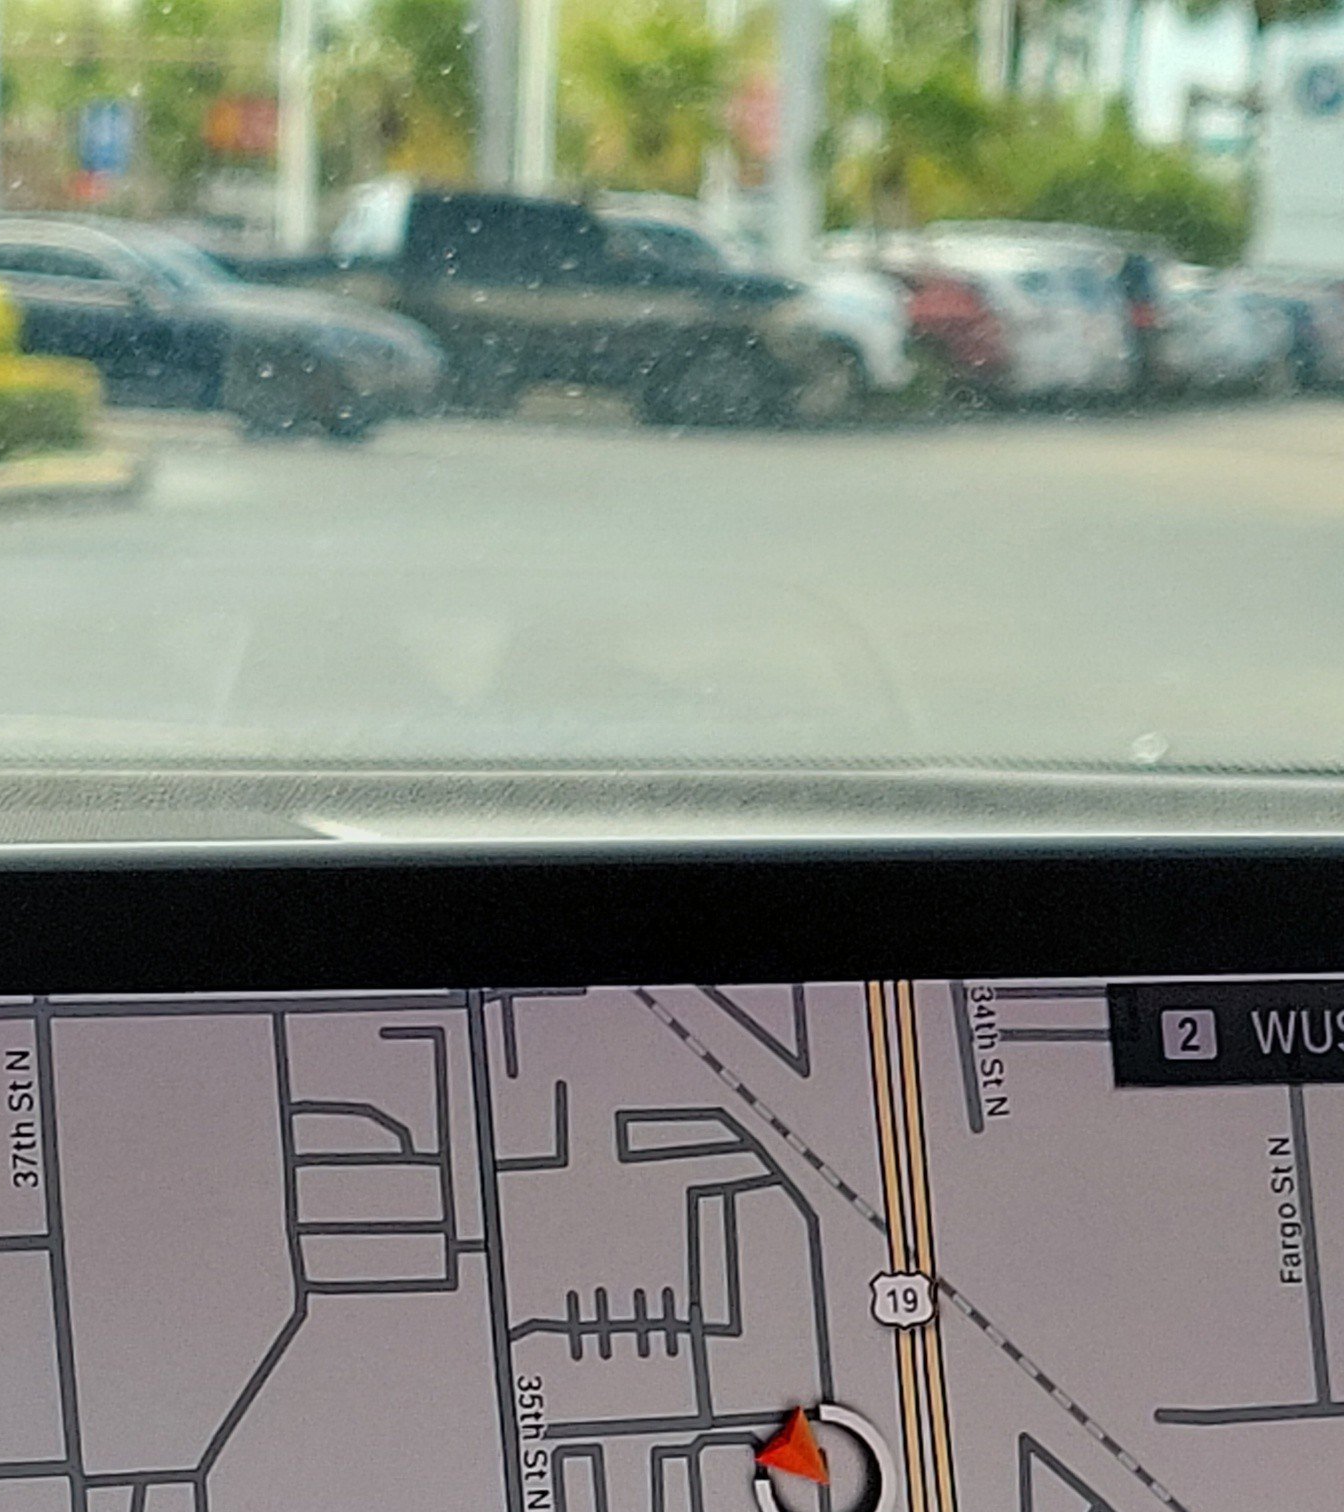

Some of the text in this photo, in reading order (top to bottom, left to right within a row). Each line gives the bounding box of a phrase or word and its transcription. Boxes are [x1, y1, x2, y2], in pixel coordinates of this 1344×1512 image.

[971, 986, 1010, 1116] 34th St N
[1176, 1016, 1201, 1051] 2
[5, 1051, 39, 1188] 37th St N
[1268, 1137, 1302, 1284] Fargo St N
[886, 1287, 918, 1313] 19
[517, 1375, 551, 1510] 35th St N
